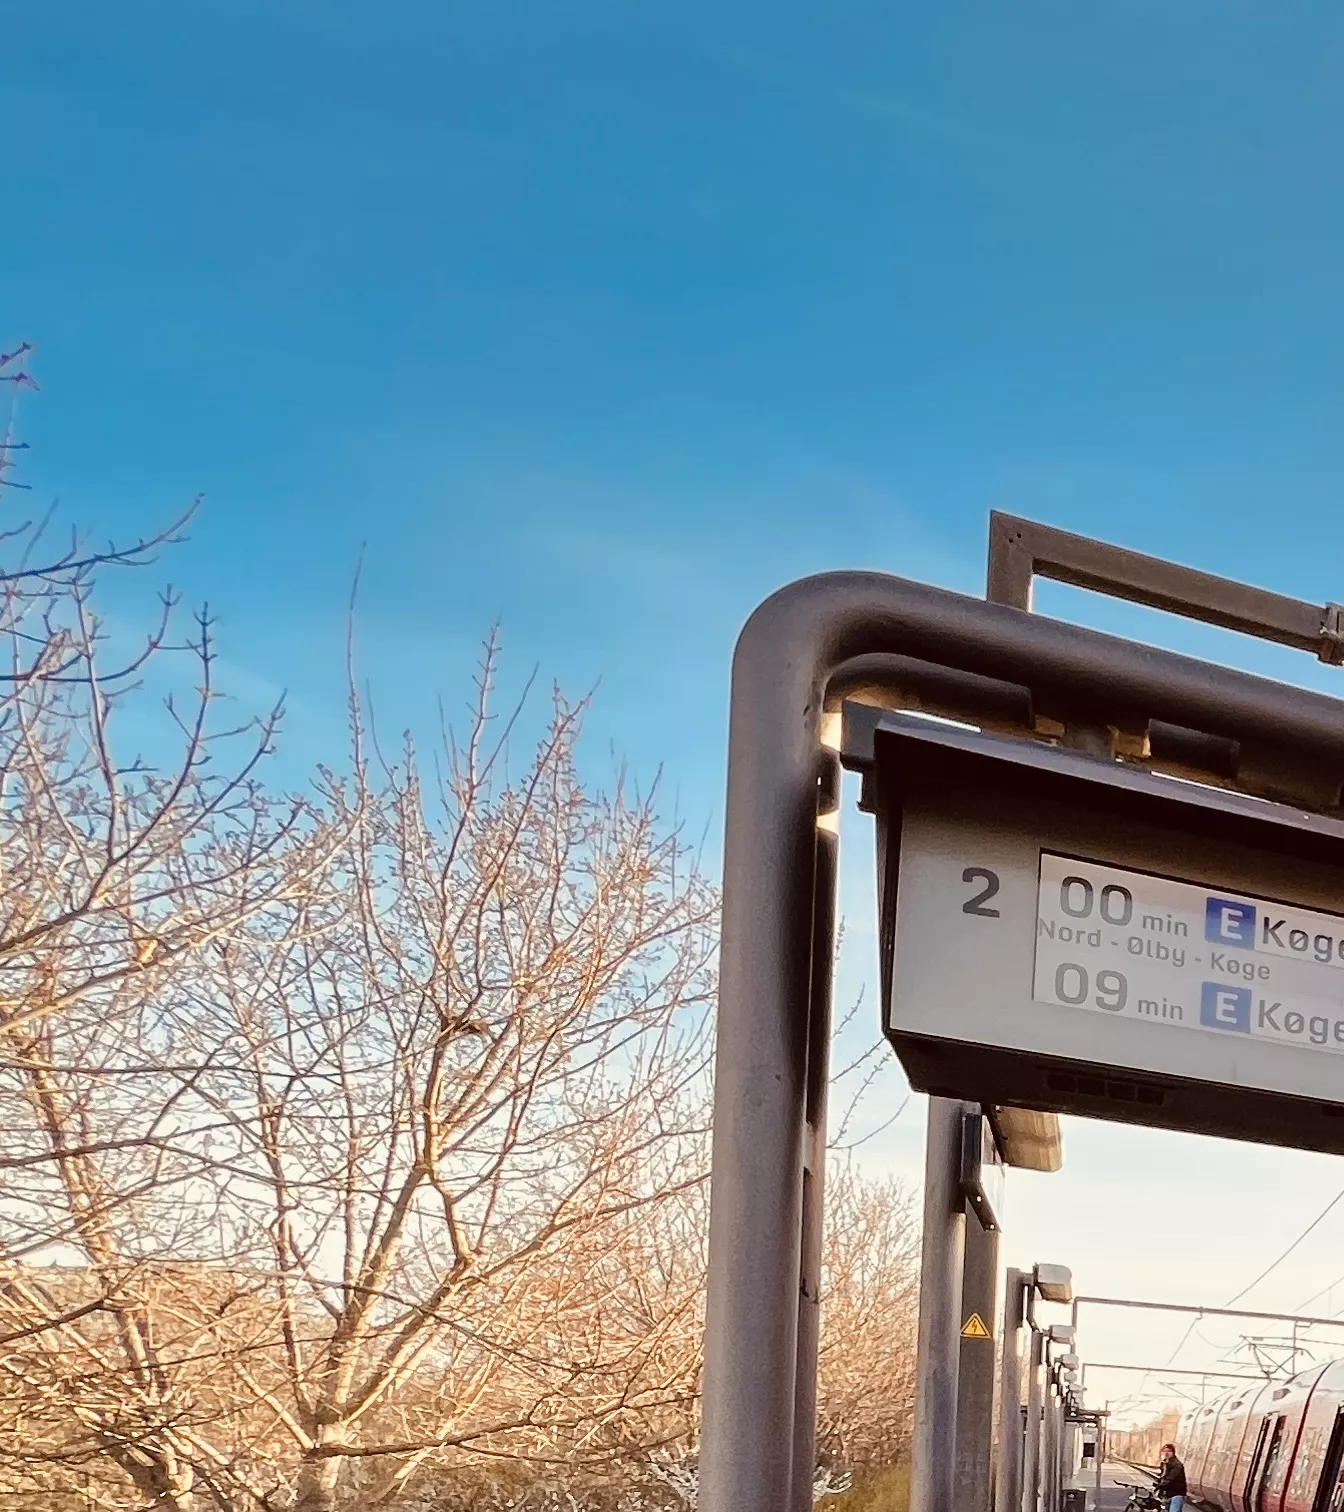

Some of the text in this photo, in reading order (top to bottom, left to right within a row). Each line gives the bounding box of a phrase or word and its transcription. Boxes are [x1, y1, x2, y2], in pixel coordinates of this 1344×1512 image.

[962, 867, 1000, 918] 2
[1059, 876, 1133, 926] 00
[1142, 913, 1188, 937] min
[1220, 907, 1243, 940] E
[1038, 918, 1101, 948] Nord
[1127, 936, 1185, 968] Ølby
[1210, 952, 1271, 981] Køge
[1054, 962, 1128, 1012] 09
[1137, 998, 1183, 1021] min
[1216, 991, 1238, 1024] E
